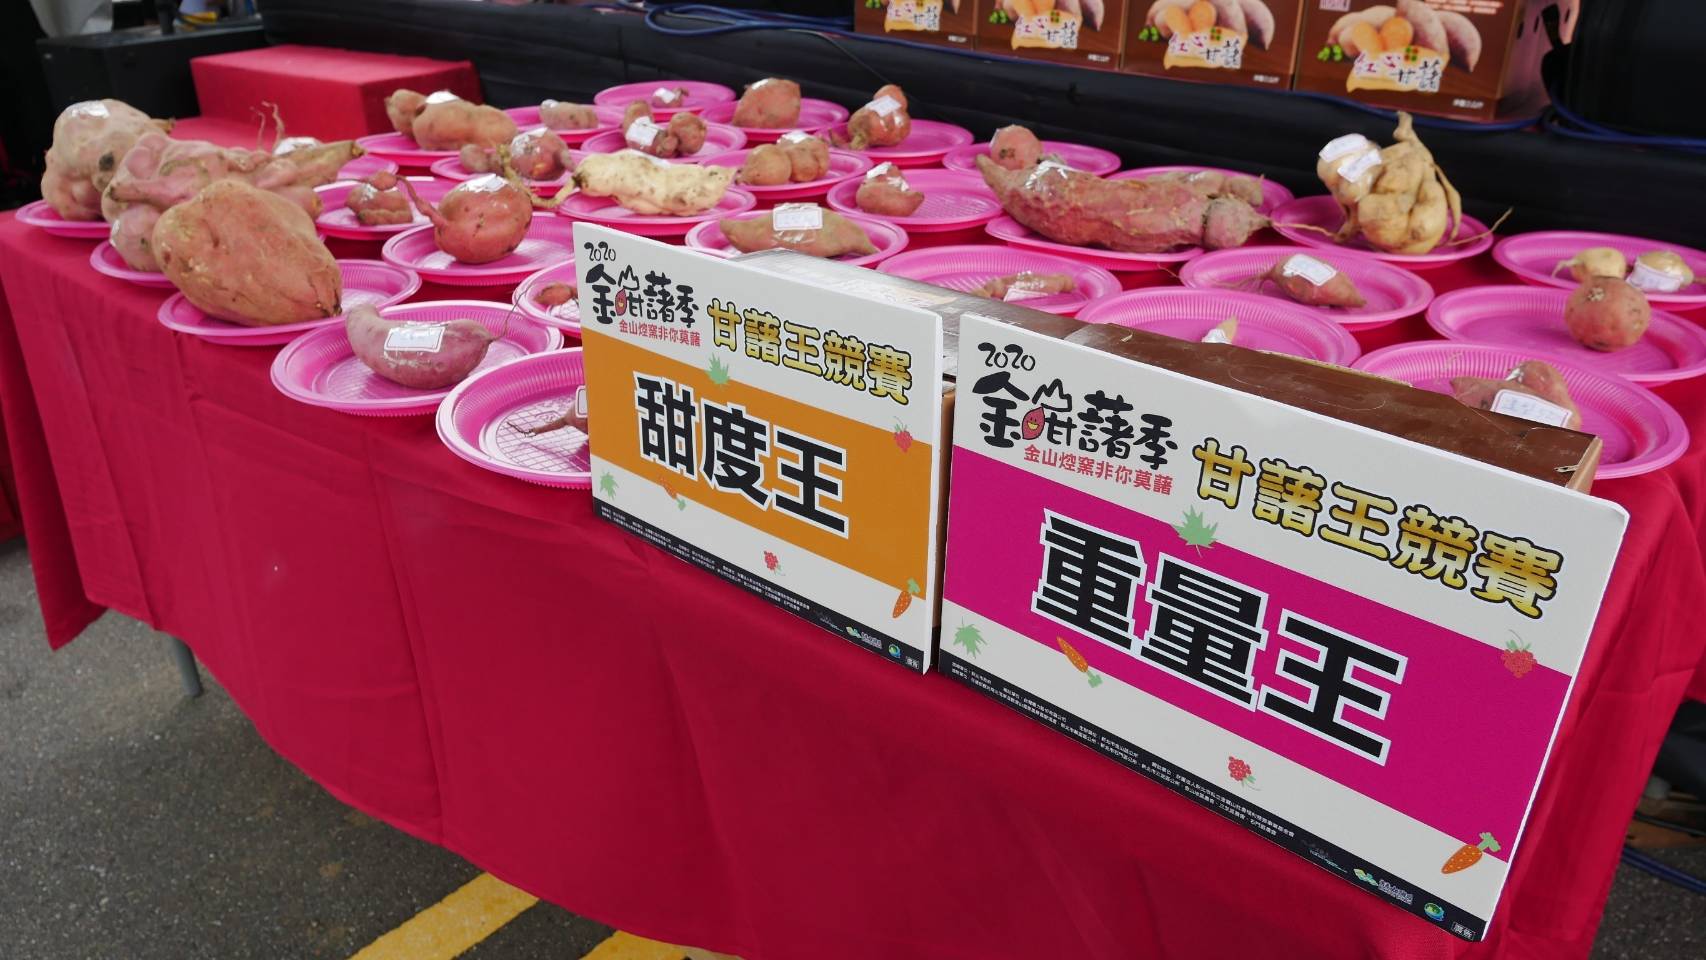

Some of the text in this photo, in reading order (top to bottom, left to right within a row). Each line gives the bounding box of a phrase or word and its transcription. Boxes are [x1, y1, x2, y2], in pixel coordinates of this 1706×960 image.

[584, 242, 616, 262] 2020
[707, 298, 912, 405] 甘藷王競賽
[978, 342, 1036, 371] 2020
[635, 373, 848, 537] 甜度王
[1024, 444, 1174, 496] 金山焢窯非你莫藷
[1192, 437, 1563, 619] 甘藷王競賽
[1031, 508, 1408, 766] 重量王
